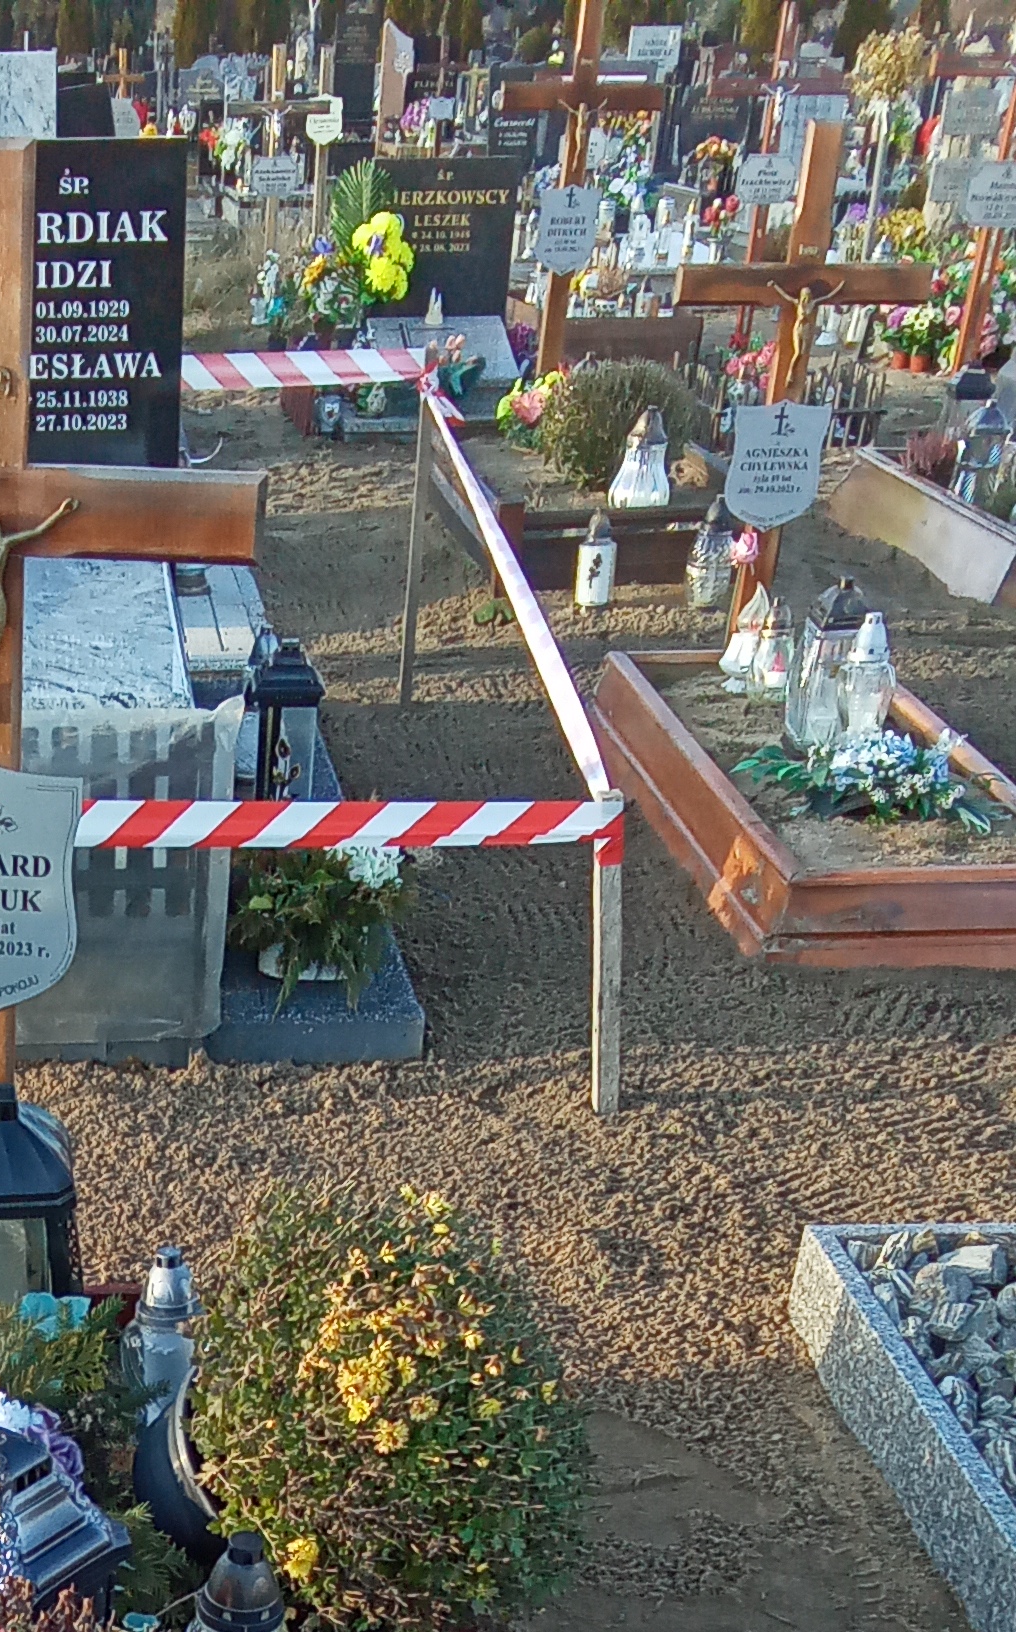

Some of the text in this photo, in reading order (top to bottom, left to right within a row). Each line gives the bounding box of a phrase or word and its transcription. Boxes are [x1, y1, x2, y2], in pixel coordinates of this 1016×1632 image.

[381, 188, 510, 206] IERZKOWSCY
[36, 209, 169, 244] RDIAK
[414, 213, 471, 227] LESZEK
[35, 259, 113, 289] IDZI
[35, 299, 131, 319] 01.09.1929
[35, 323, 130, 343] 30.07.2024
[29, 351, 163, 380] ESŁAWA
[35, 389, 129, 408] 25.11.1938
[35, 412, 128, 432] 27.10.2023
[745, 447, 809, 458] AGNIESZKA
[37, 946, 51, 958] r.
